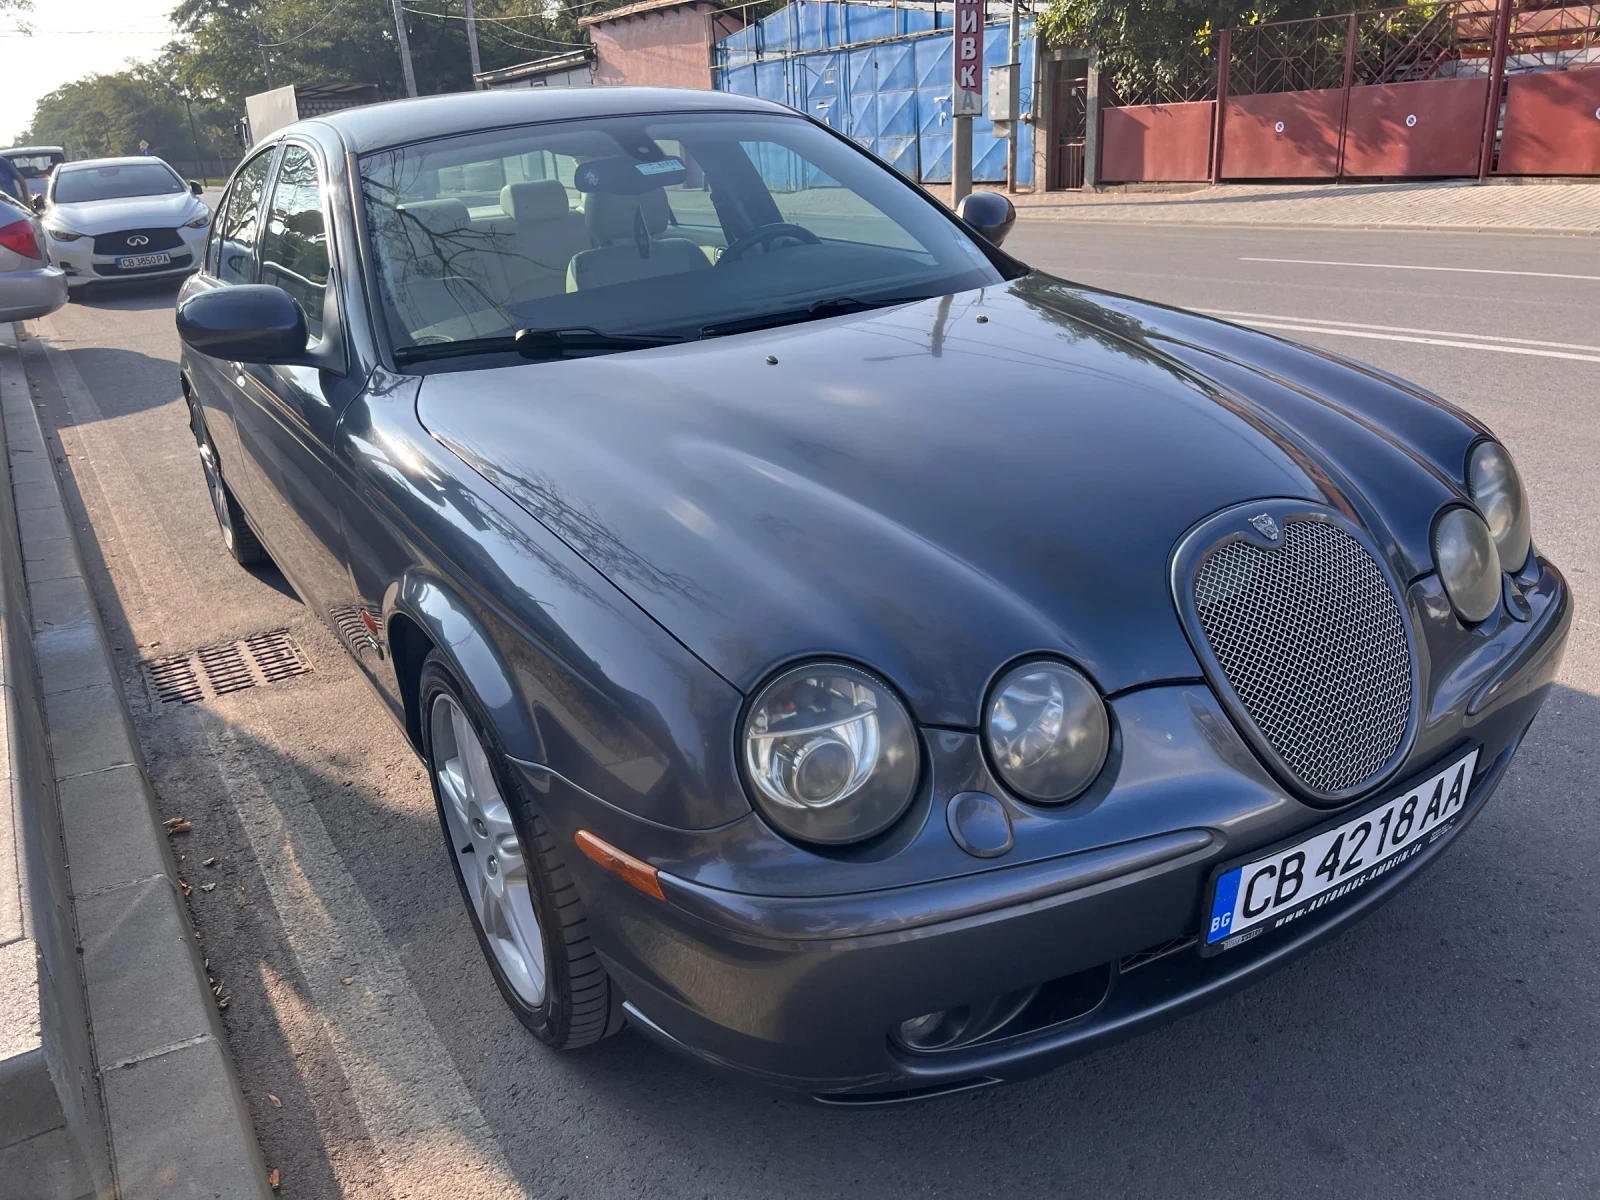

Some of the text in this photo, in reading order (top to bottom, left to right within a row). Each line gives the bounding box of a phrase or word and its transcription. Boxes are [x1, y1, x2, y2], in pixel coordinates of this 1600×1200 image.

[960, 0, 978, 110] ИВКА
[122, 259, 135, 268] CB
[135, 256, 156, 266] 3850
[157, 254, 169, 264] PA
[1242, 762, 1466, 919] CB 4218 AA
[1210, 911, 1231, 933] BG
